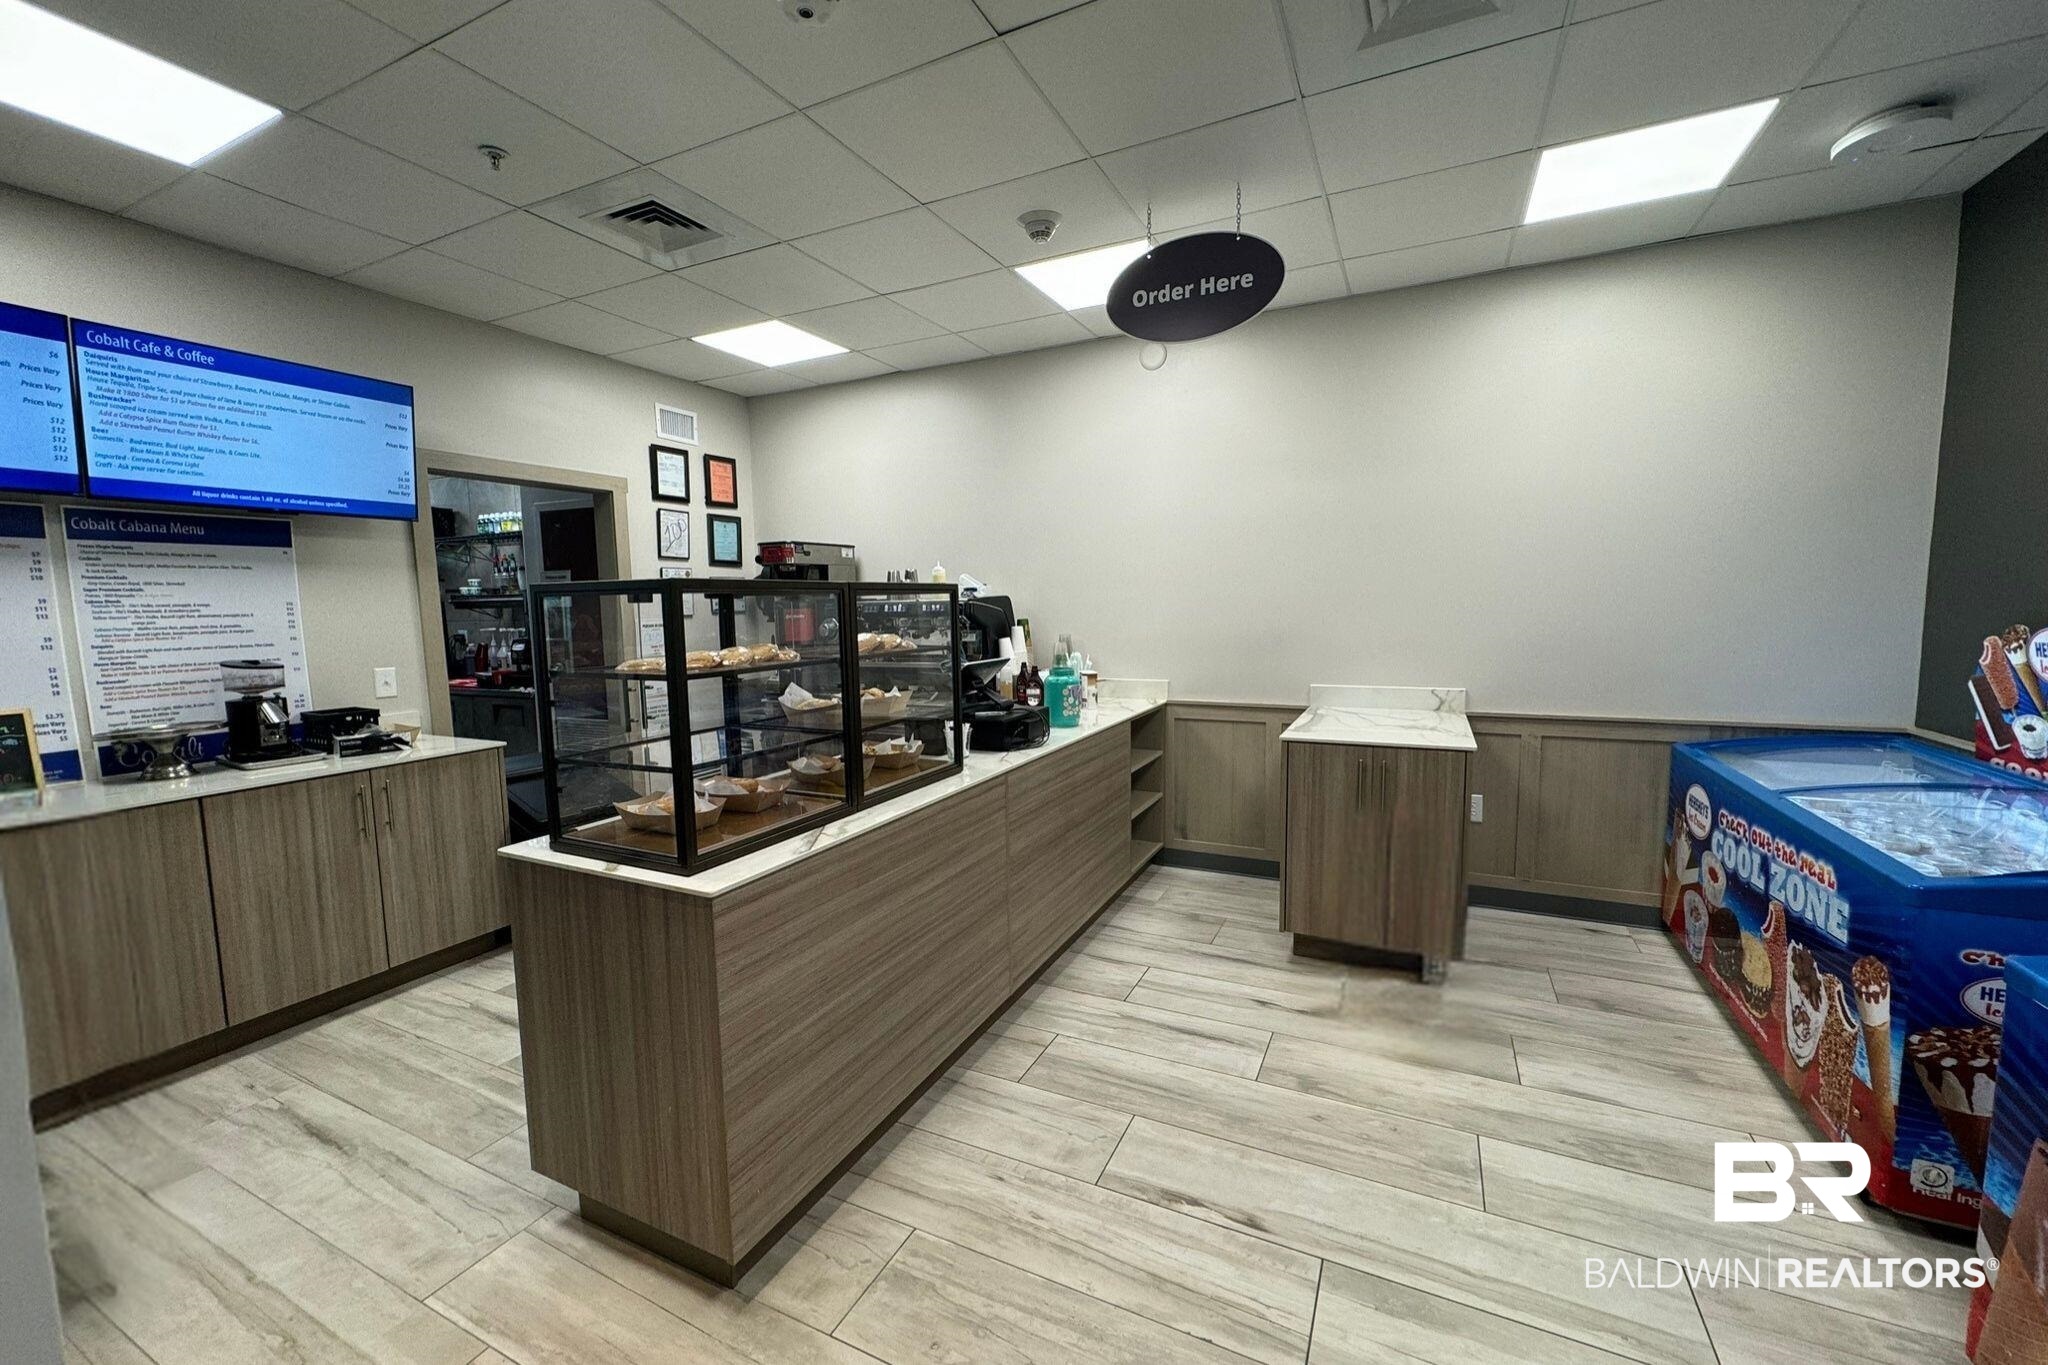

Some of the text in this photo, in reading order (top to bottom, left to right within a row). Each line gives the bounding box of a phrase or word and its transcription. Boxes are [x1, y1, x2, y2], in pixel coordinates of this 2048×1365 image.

[1132, 272, 1254, 308] Order Here
[85, 329, 214, 365] Cobalt Cafe & Coffee
[19, 362, 60, 376] Prices Vary
[85, 367, 149, 383] House Margaritas
[21, 380, 62, 393] Prices Vary
[23, 396, 64, 410] Prices Vary
[50, 417, 65, 425] $12
[52, 426, 66, 434] $12
[53, 435, 68, 444] $12
[54, 444, 68, 452] $12
[54, 454, 69, 462] $12
[70, 516, 204, 535] Cobalt Cabana Menu
[1711, 830, 1849, 945] COOL ZONE
